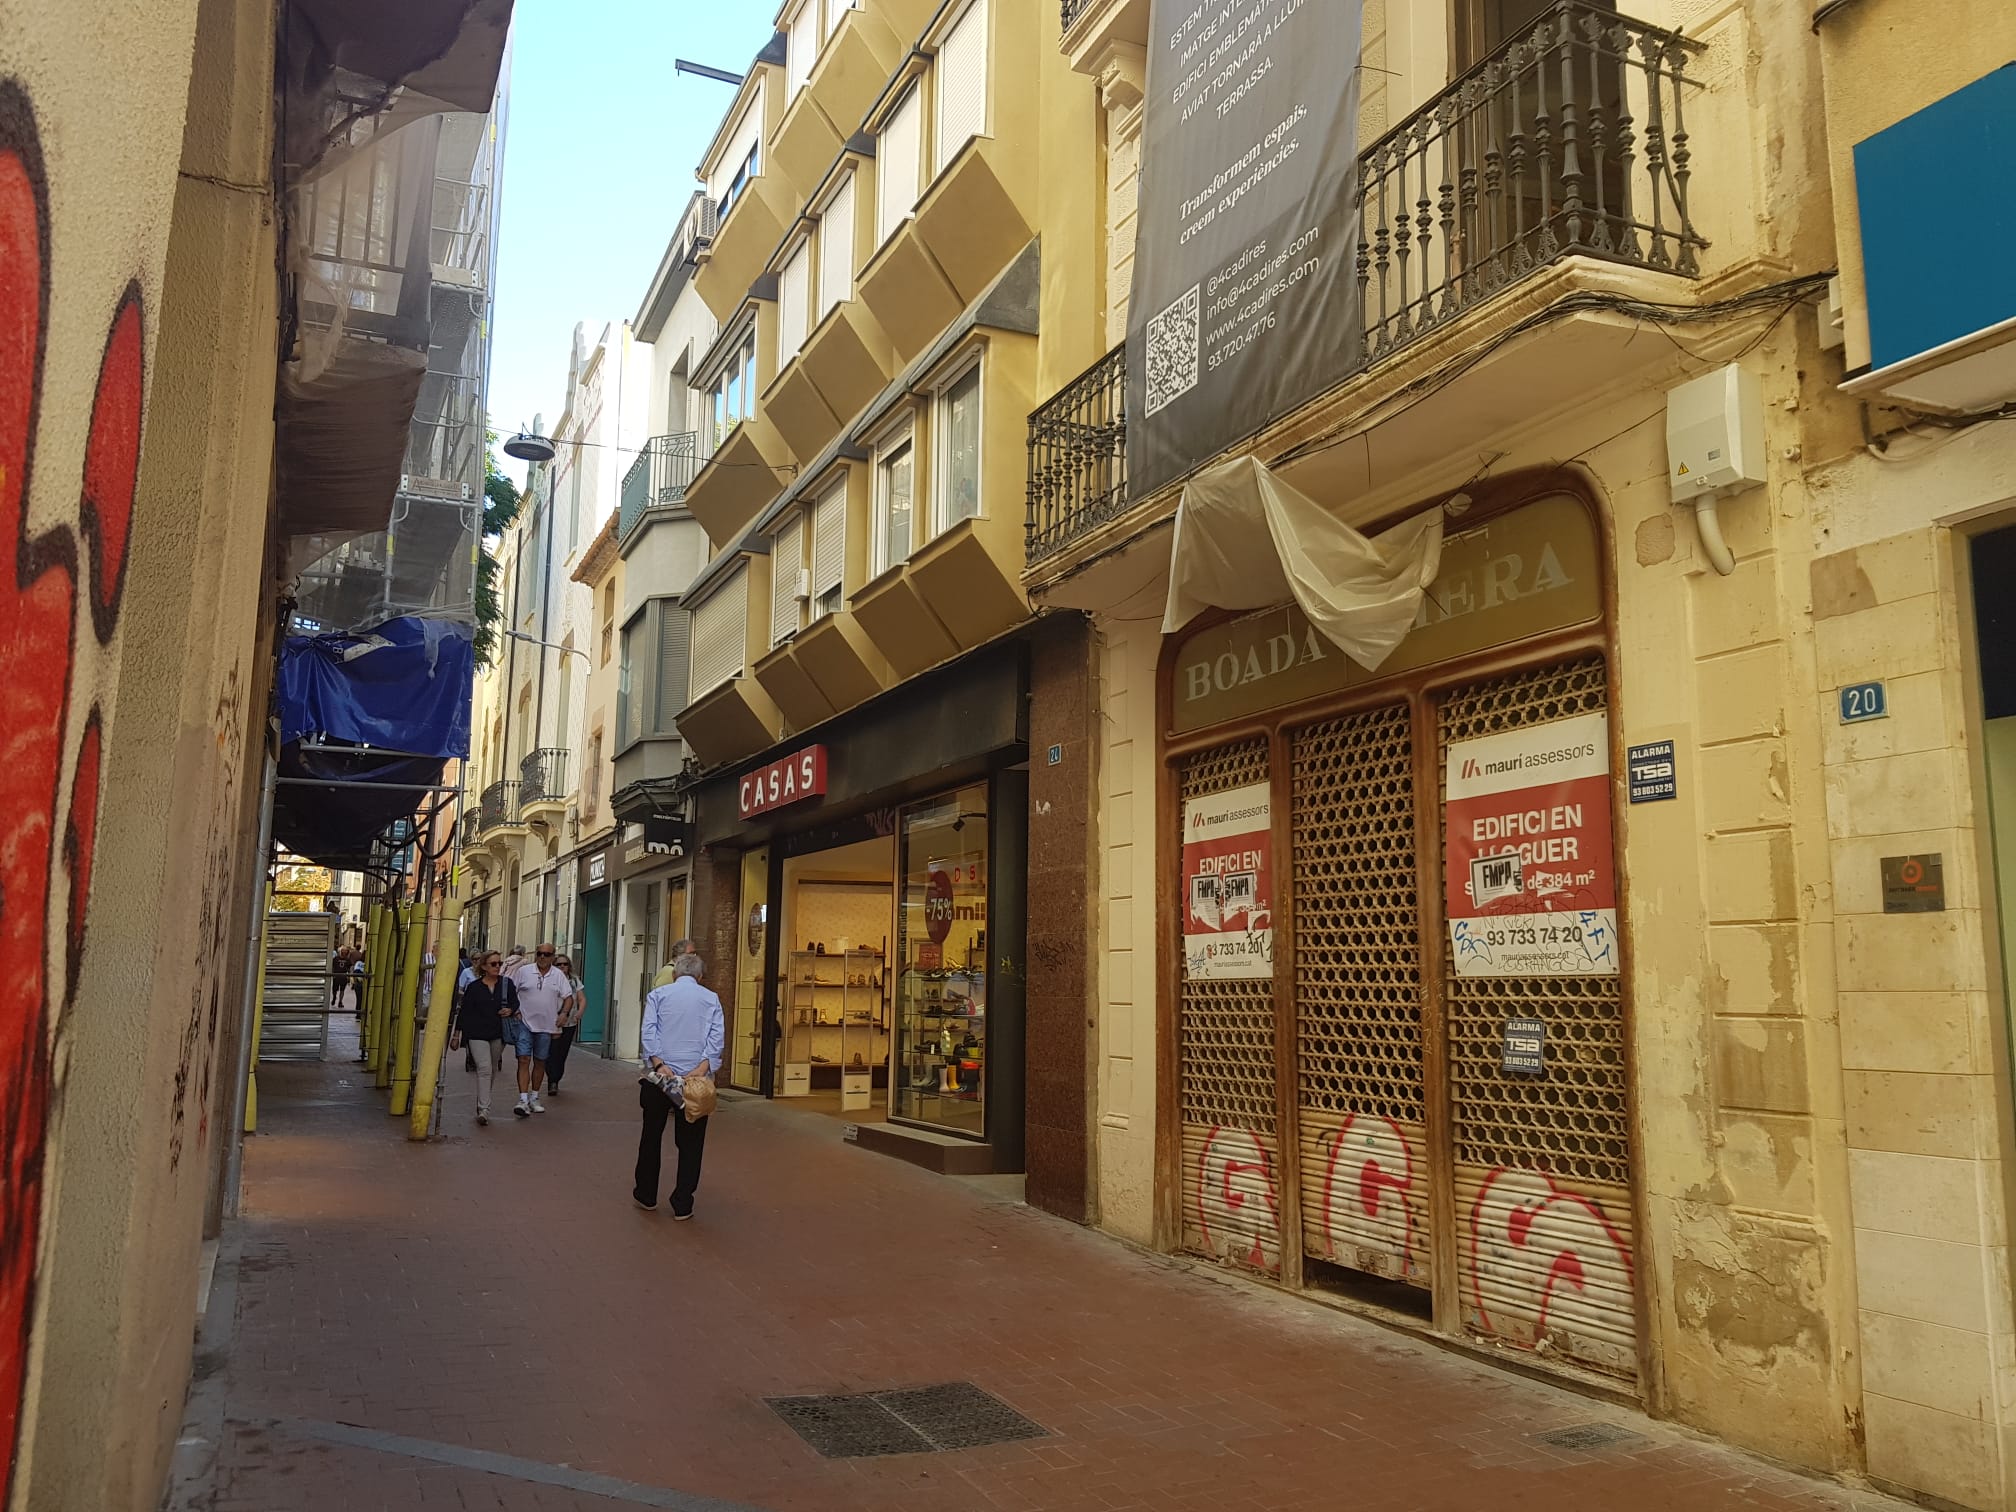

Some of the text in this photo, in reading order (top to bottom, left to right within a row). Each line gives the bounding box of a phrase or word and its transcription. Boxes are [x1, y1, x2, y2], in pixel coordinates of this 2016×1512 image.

[1170, 5, 1202, 50] ESTEM
[1180, 17, 1218, 69] IMATGE
[1173, 59, 1207, 104] EDIFICI
[1181, 85, 1211, 126] AVIAT
[1212, 30, 1262, 94] TORNARÀ
[1263, 23, 1272, 42] A
[1216, 56, 1274, 120] TERRASSA.
[1180, 103, 1308, 220] Transformem espais,
[1180, 138, 1300, 245] creem experiències.
[1206, 240, 1266, 296] @4cadires
[1206, 226, 1319, 320] info@4cadires.com
[1206, 257, 1319, 346] www.4cadires.com
[1207, 311, 1276, 371] 93.720.47.76
[1185, 541, 1575, 702] BOADA IERA
[1848, 687, 1877, 716] 20
[1485, 743, 1595, 776] maurí assessors
[1631, 745, 1671, 760] ALARMA
[741, 755, 813, 813] CASAS
[1633, 787, 1642, 797] 93
[1655, 784, 1664, 793] 52
[1229, 804, 1269, 822] assessors
[1472, 803, 1582, 841] EDIFICI EN
[1200, 849, 1262, 875] EDIFICI EN
[1482, 861, 1512, 889] FMPA
[1527, 874, 1544, 890] de
[1546, 871, 1573, 888] 384
[1575, 869, 1596, 886] m²
[926, 898, 952, 921] -75%
[1219, 943, 1235, 956] 733
[1236, 942, 1246, 955] 74
[1248, 941, 1260, 954] 20
[1487, 926, 1583, 946] 93 733 74 20
[1508, 1022, 1541, 1032] ALARMA
